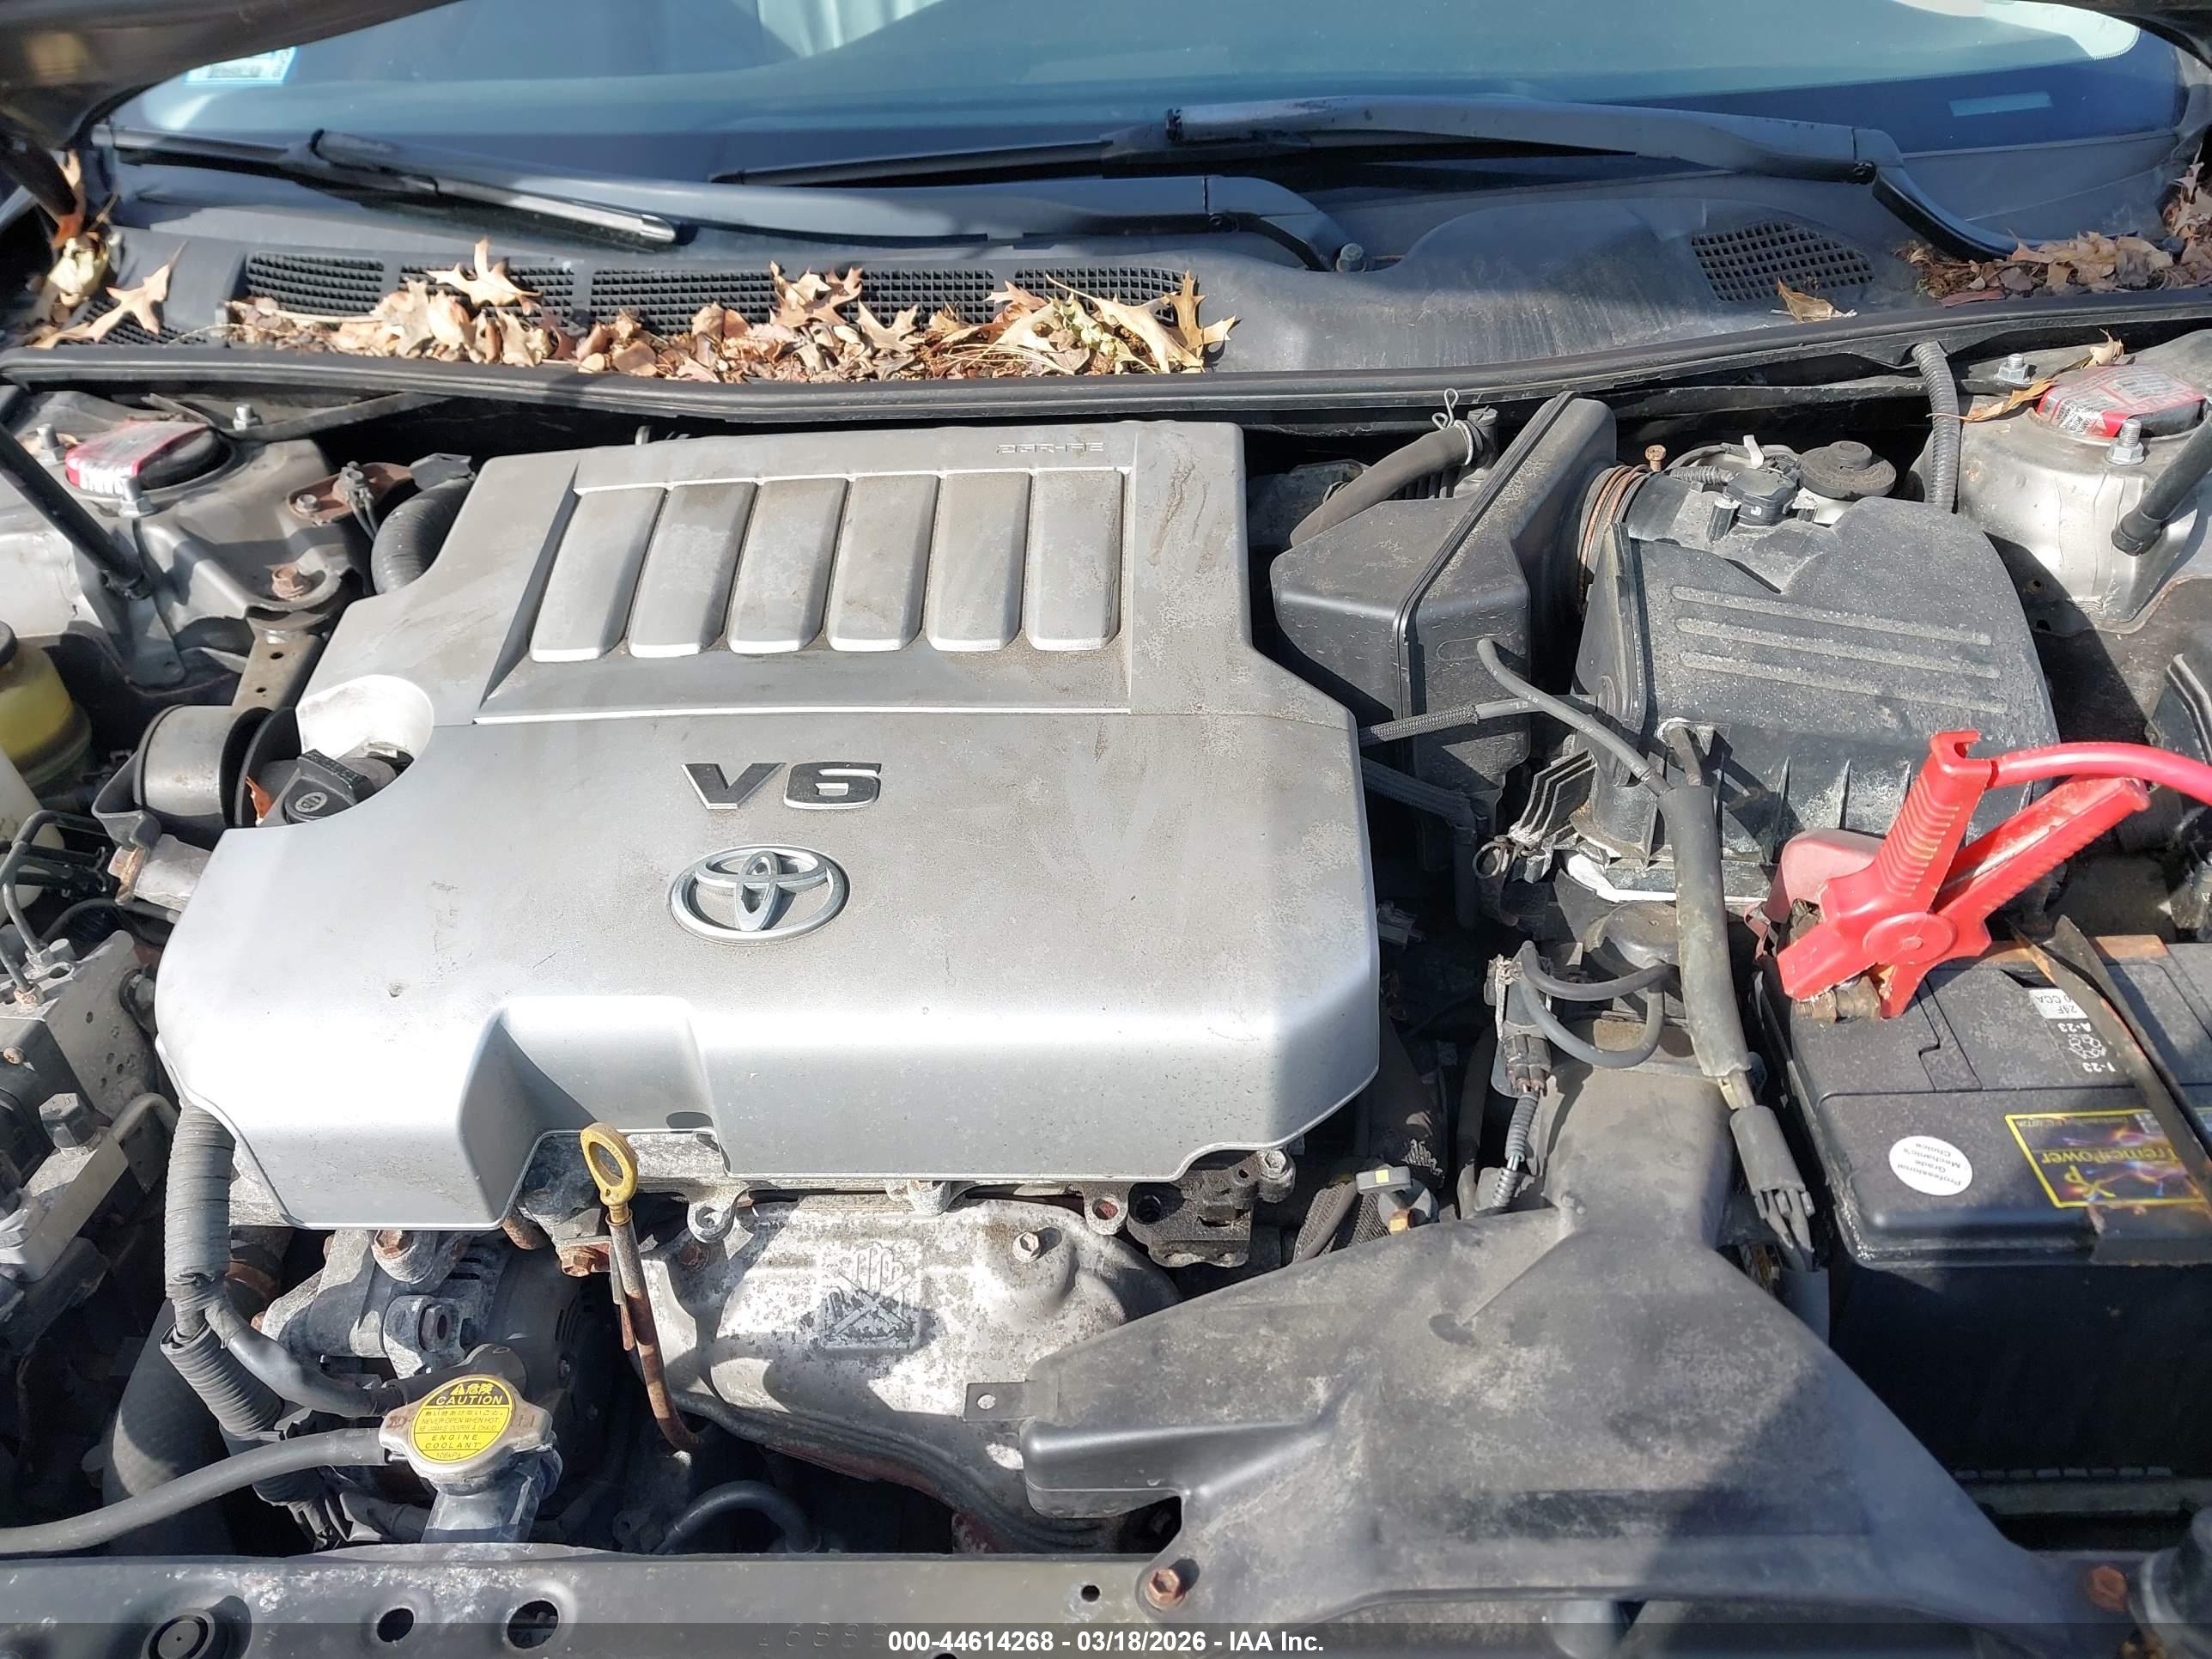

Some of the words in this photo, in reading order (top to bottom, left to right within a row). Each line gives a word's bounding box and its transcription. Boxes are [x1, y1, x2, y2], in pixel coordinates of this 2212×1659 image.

[681, 762, 882, 809] V6
[2035, 995, 2062, 1004] CCA
[2057, 1023, 2092, 1033] A-23
[1916, 1143, 1951, 1158] Choice
[1915, 1159, 1946, 1173] Grade
[1898, 1164, 1961, 1186] Professional
[465, 1382, 495, 1395] 危険
[435, 1395, 503, 1406] CAUTION
